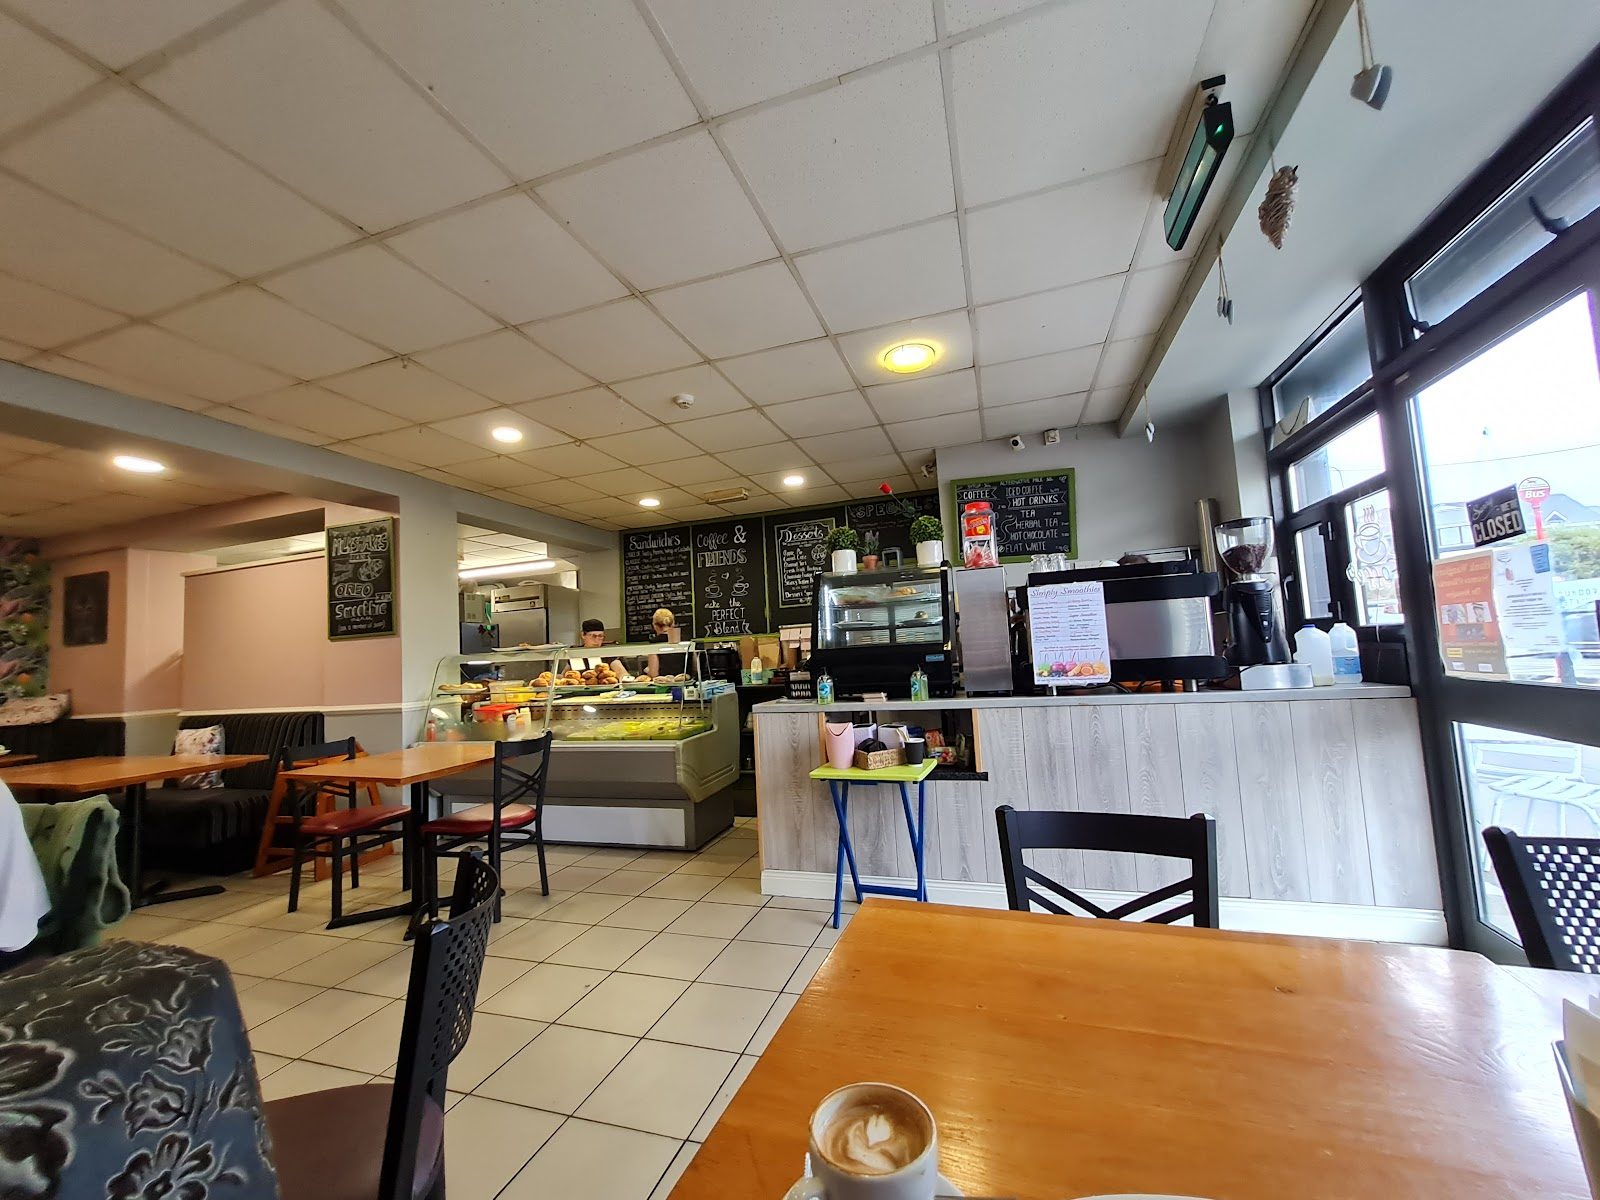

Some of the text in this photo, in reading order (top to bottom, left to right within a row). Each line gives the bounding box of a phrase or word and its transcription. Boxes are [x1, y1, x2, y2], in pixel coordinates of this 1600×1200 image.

[963, 489, 991, 500] COFFEE
[1006, 486, 1021, 496] ICED
[1021, 485, 1042, 495] COFFEE
[1525, 490, 1546, 499] BUS
[1012, 497, 1026, 507] HOT
[1029, 494, 1059, 505] DRINKS
[1021, 509, 1036, 518] TEA
[1015, 518, 1059, 530] HERBAL TEA
[1472, 510, 1523, 543] CLOSED
[629, 531, 681, 550] Sandwiches
[697, 525, 747, 550] Coffee &
[1010, 531, 1022, 541] HOT
[1022, 529, 1059, 539] CHOCOLATE
[1005, 542, 1023, 553] FLAT
[1025, 540, 1046, 551] WHITE
[697, 548, 748, 568] FRIENDS
[335, 582, 374, 598] OREO
[1030, 583, 1101, 599] Simply Smoothies
[729, 597, 742, 607] the
[711, 607, 745, 621] PERFECT
[714, 621, 741, 635] Blend
